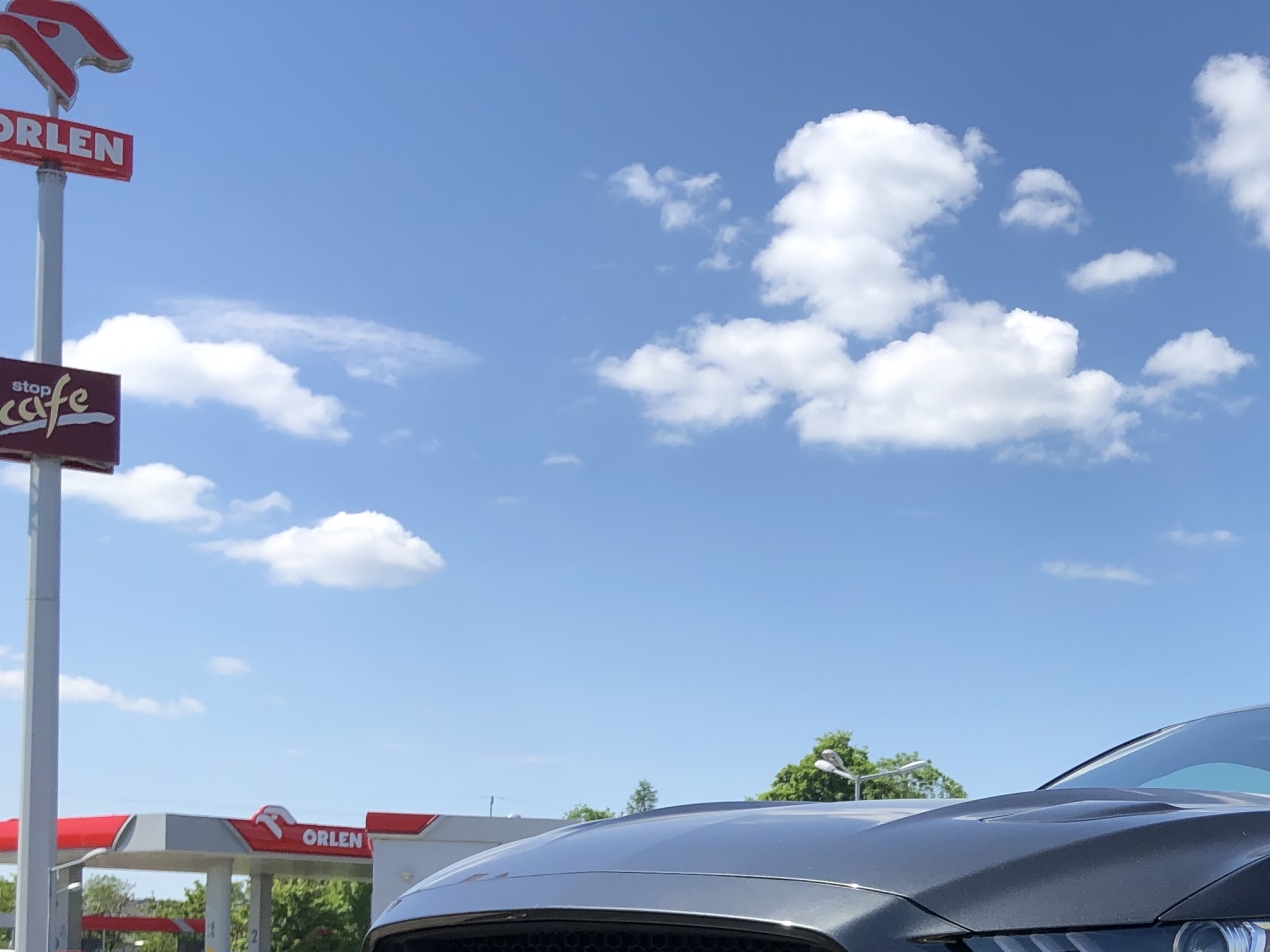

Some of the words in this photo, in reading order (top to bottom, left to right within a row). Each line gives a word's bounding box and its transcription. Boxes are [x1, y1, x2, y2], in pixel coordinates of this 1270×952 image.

[12, 381, 51, 398] stop
[303, 829, 362, 848] ORLEN
[251, 929, 258, 943] 2
